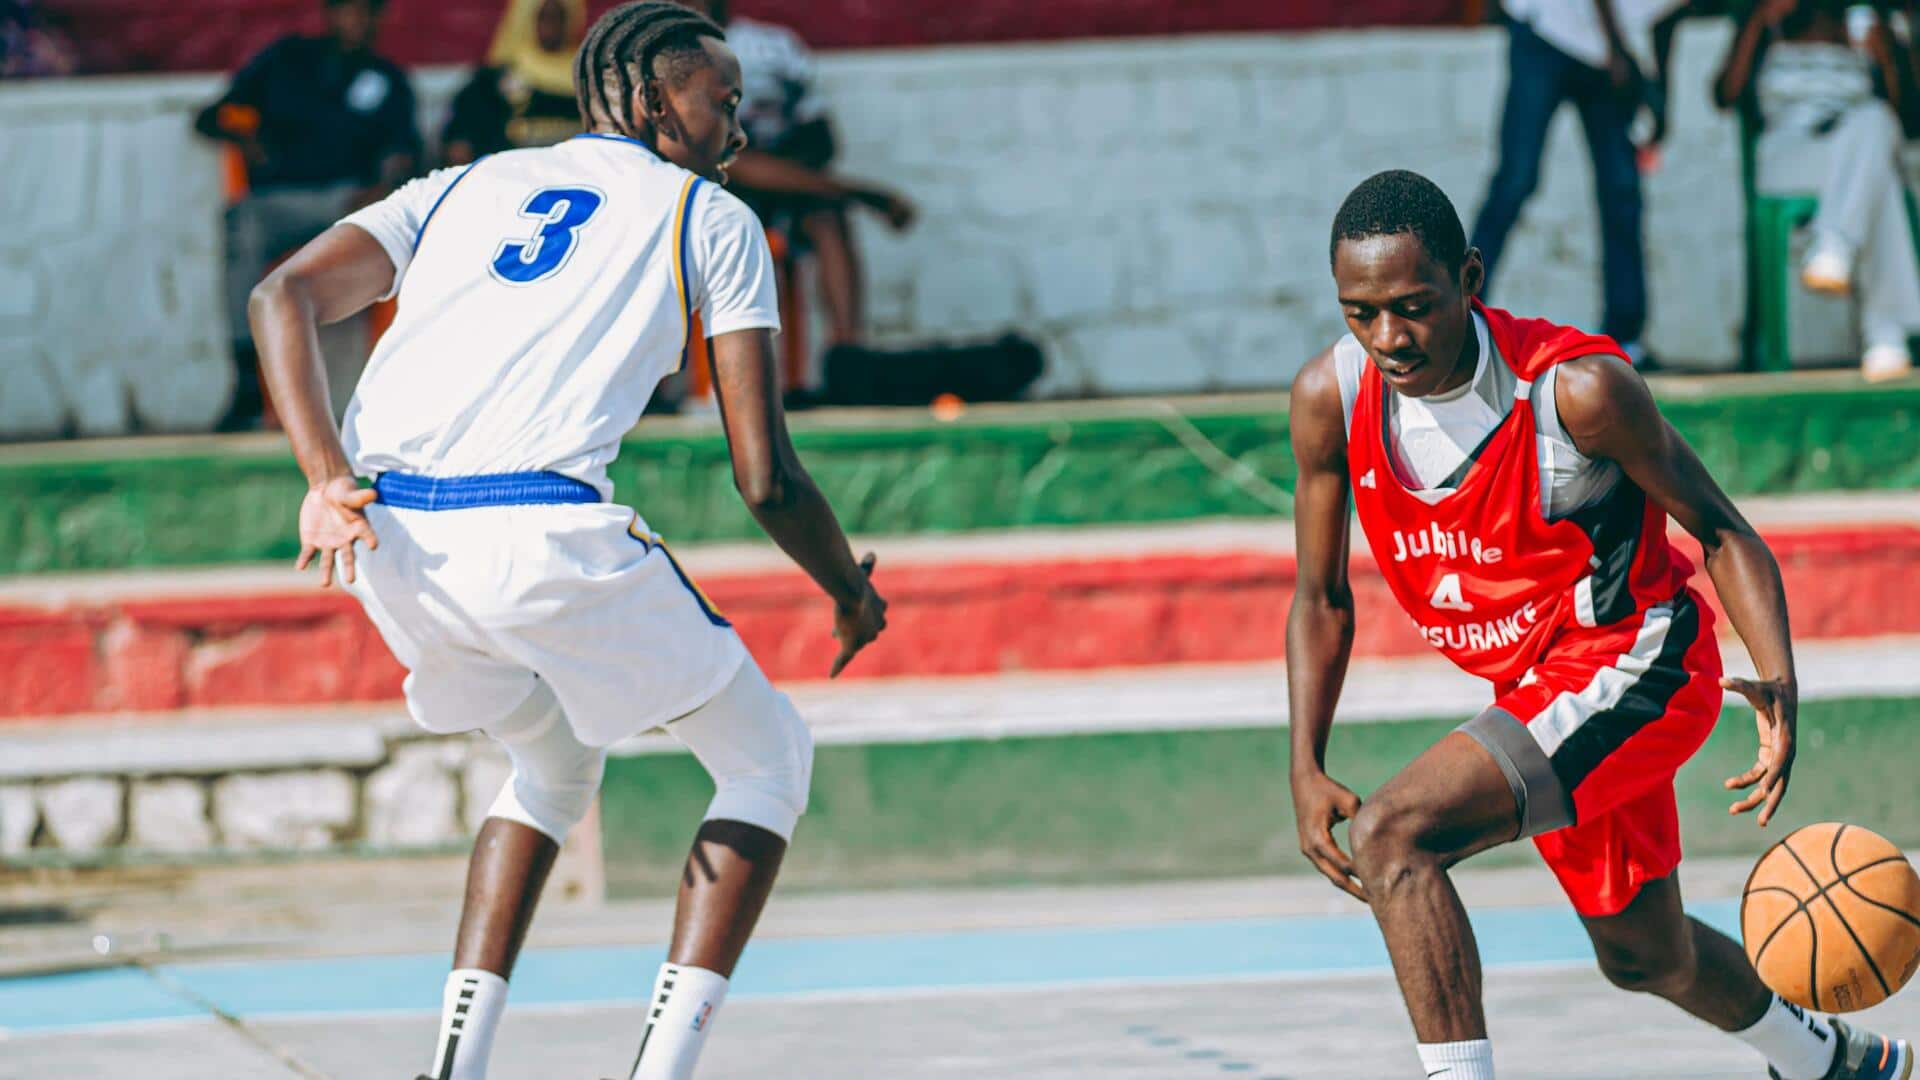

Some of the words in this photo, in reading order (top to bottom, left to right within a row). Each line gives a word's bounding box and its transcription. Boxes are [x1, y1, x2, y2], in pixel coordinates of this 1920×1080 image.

[489, 184, 607, 287] 3
[1430, 574, 1473, 612] 4
[1413, 601, 1536, 650] SURANCE
